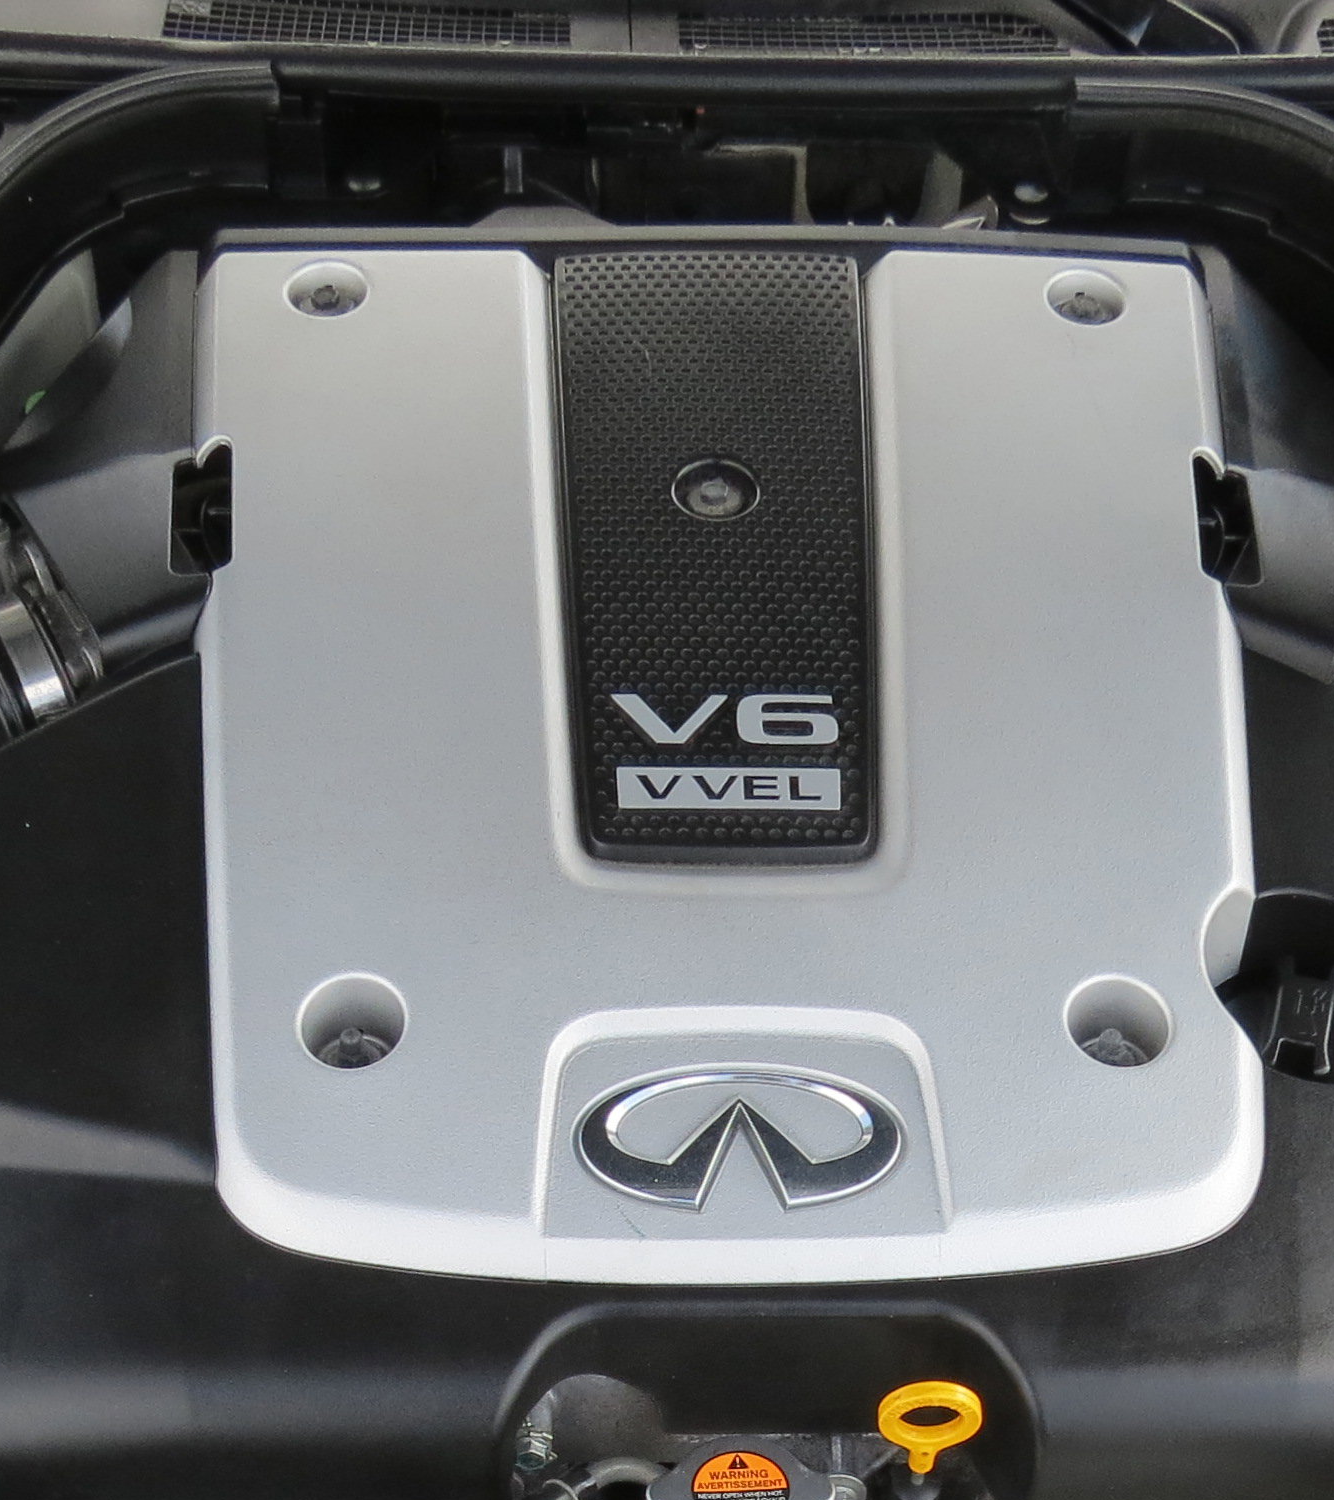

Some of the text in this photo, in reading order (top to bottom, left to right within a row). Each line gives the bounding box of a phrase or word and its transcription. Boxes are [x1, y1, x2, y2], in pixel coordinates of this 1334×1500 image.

[610, 693, 839, 745] V6
[636, 774, 822, 801] VVEL
[697, 1478, 783, 1490] AVERTISSEMENT
[708, 1469, 769, 1480] WARNING
